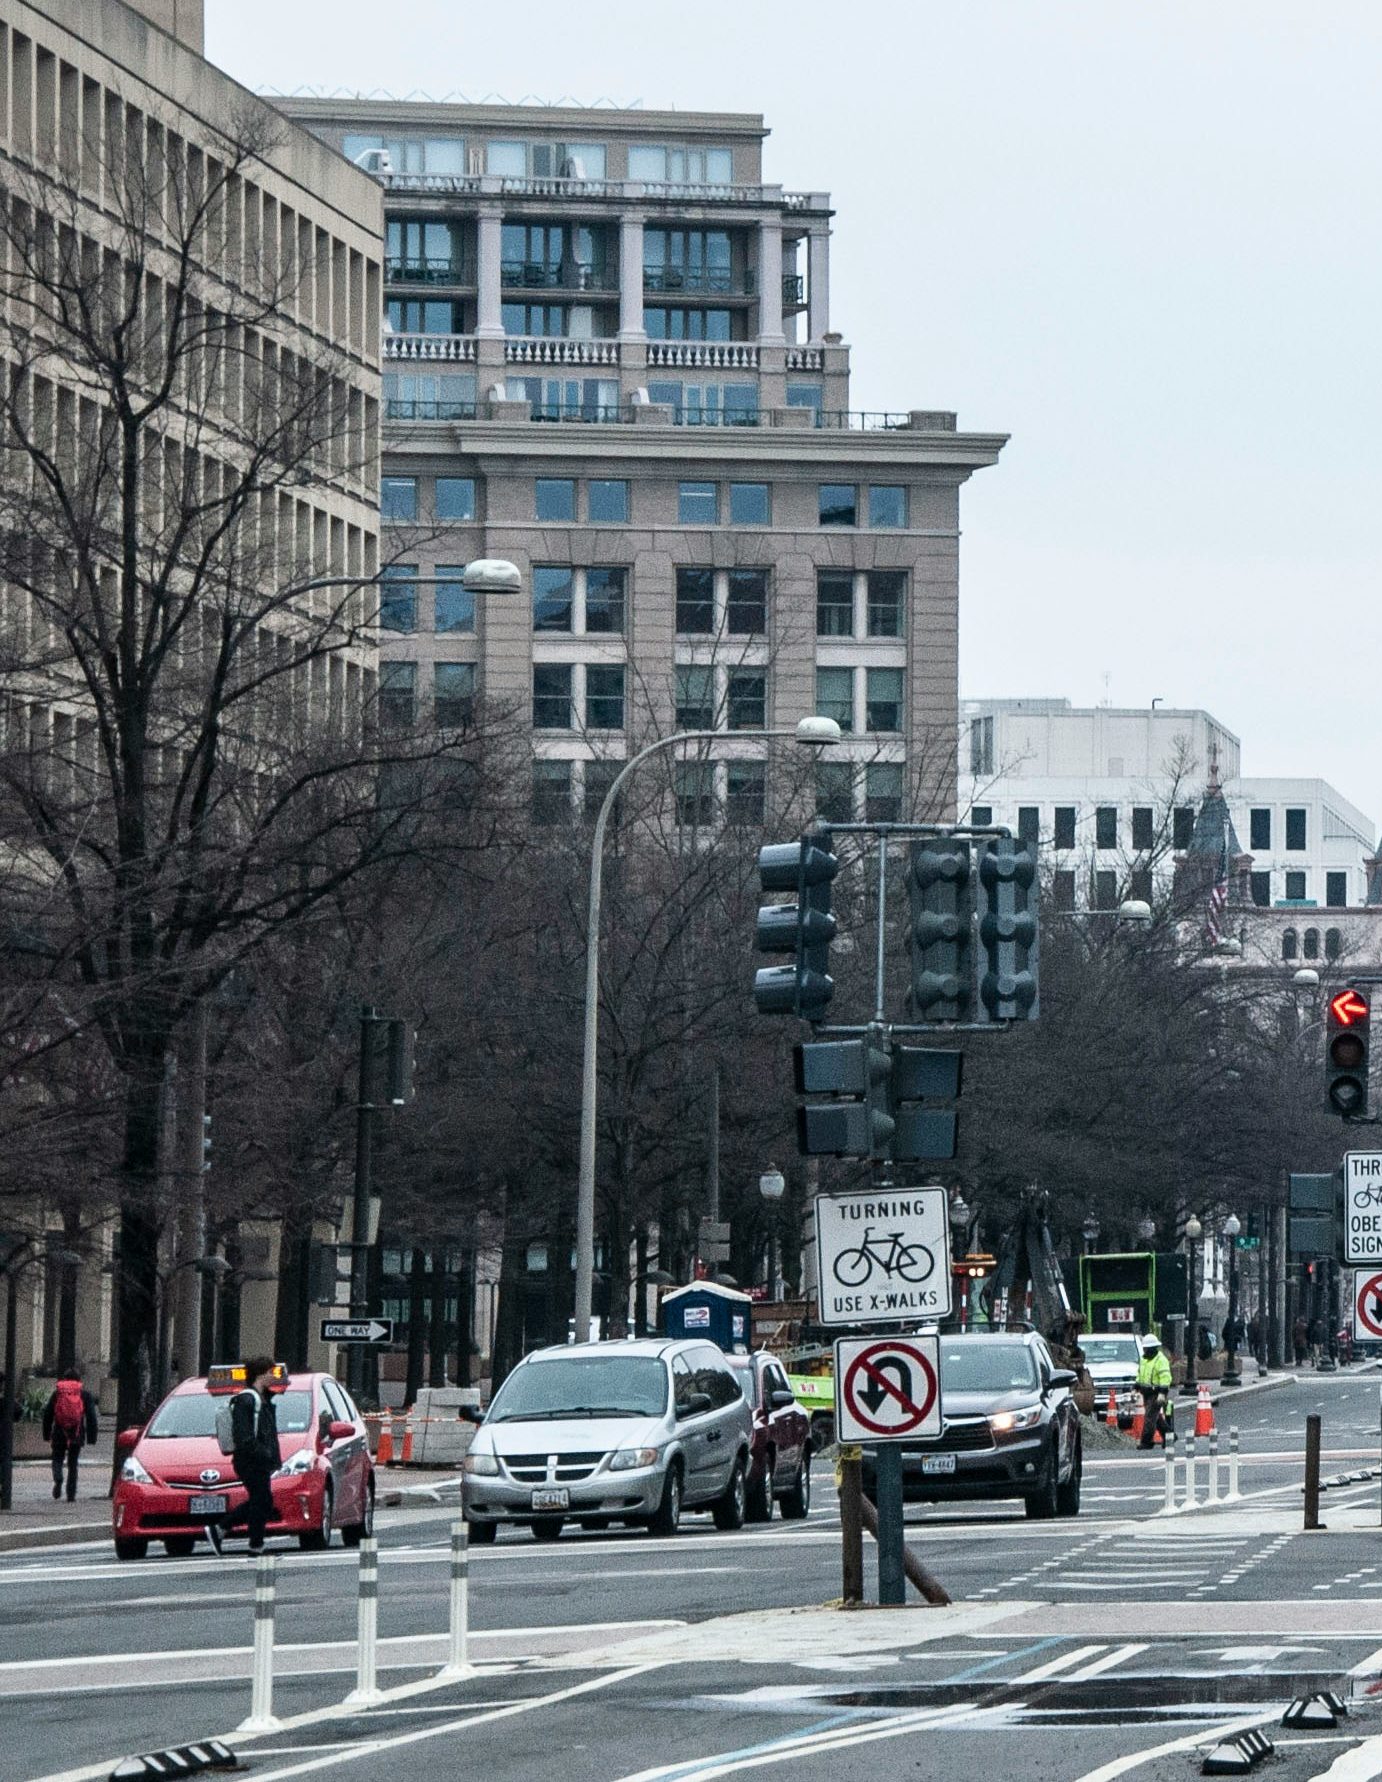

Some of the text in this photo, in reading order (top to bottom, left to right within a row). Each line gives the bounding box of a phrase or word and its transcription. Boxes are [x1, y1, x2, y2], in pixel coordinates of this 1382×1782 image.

[839, 1200, 925, 1220] TURNING
[834, 1290, 937, 1312] USE X-WALKS
[328, 1326, 370, 1335] ONE WAY
